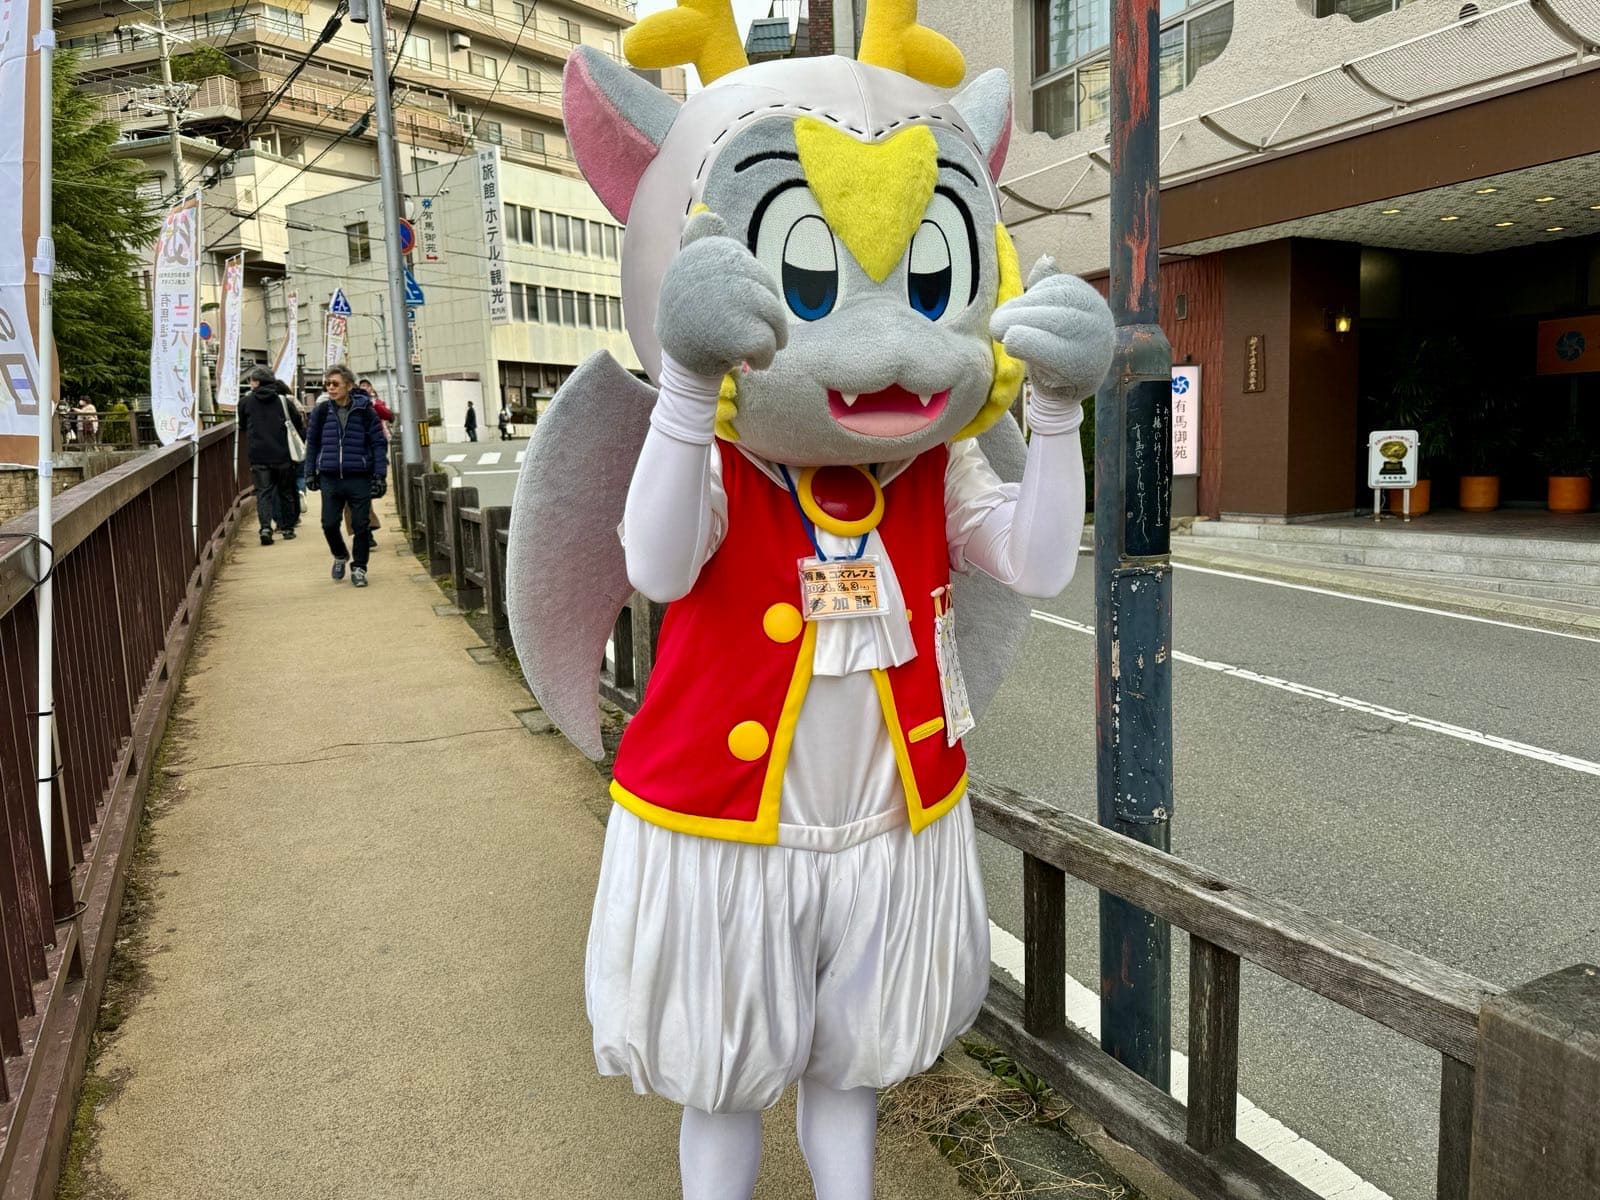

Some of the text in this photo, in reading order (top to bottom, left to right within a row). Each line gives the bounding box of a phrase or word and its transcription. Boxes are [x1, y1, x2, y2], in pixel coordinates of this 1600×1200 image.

[422, 210, 438, 253] 有馬御苑
[1174, 399, 1187, 459] 有馬御苑
[809, 595, 873, 612] 参加証
